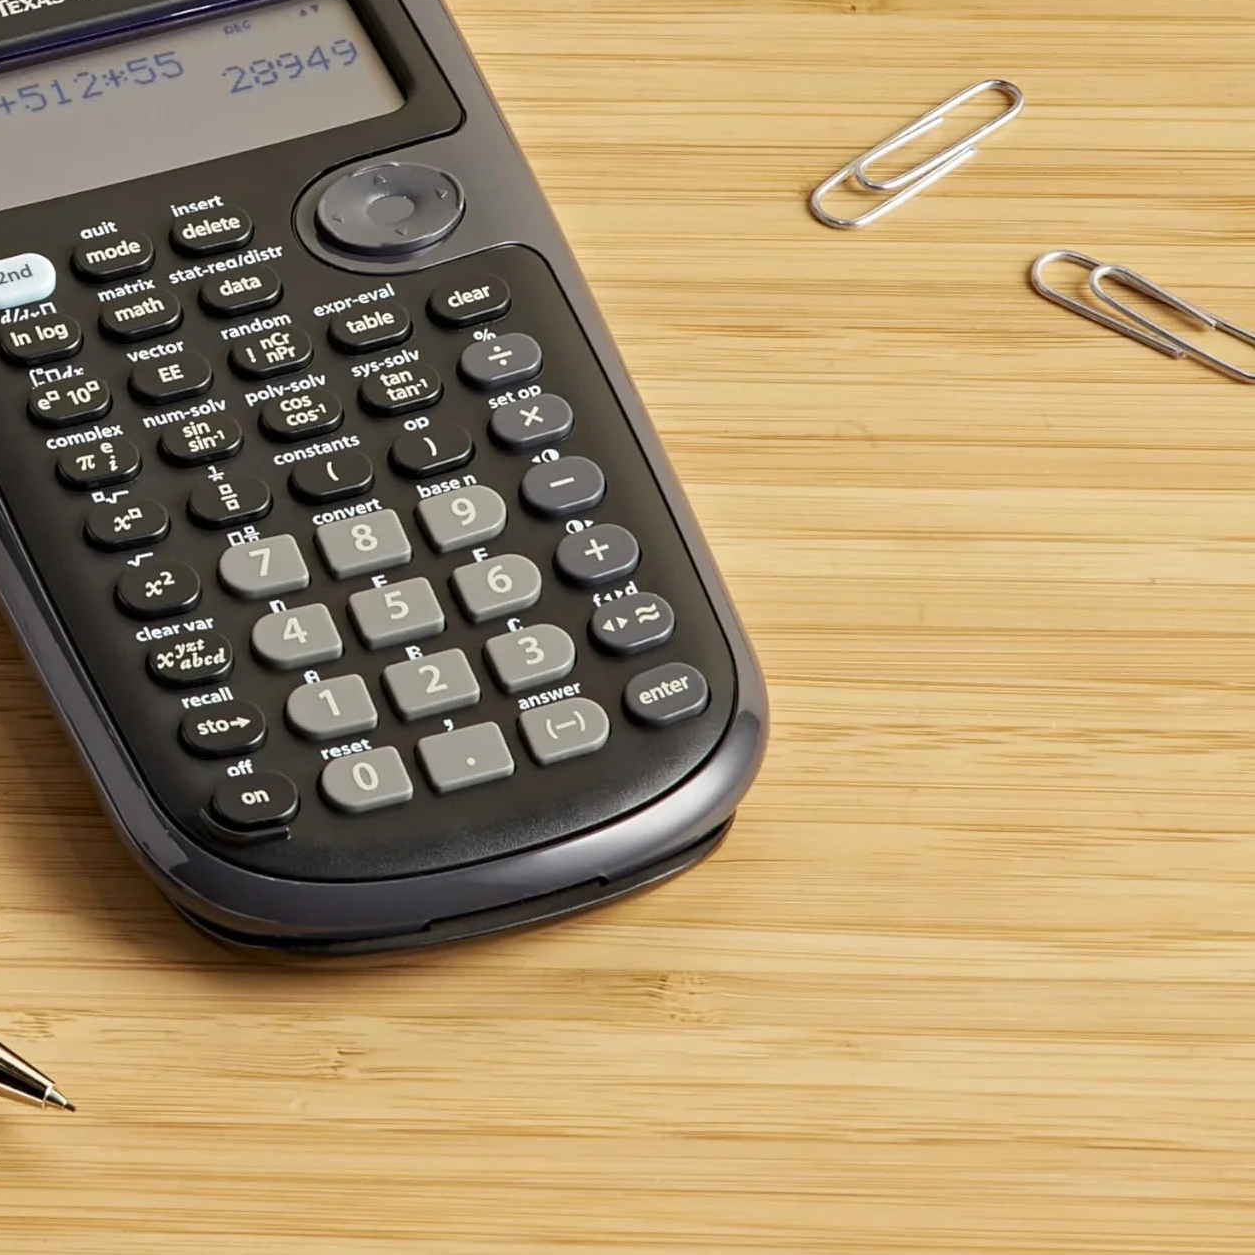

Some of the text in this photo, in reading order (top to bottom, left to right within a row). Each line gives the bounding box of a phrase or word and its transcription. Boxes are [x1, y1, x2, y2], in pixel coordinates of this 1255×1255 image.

[224, 21, 251, 35] DEG
[221, 39, 358, 93] 28949
[170, 195, 224, 218] insert
[182, 215, 241, 241] delete
[86, 239, 141, 264] mode
[97, 277, 156, 303] matrix
[219, 273, 262, 297] data
[448, 284, 490, 308] clear
[114, 296, 165, 323] math
[313, 283, 395, 318] expr-eval
[35, 323, 68, 341] log
[220, 313, 292, 341] random
[345, 311, 395, 335] table
[126, 340, 184, 364] vector
[259, 331, 290, 349] nCr
[266, 346, 296, 364] nPr
[351, 347, 420, 378] sys-solv
[158, 365, 184, 384] EE
[380, 369, 413, 387] tan
[280, 395, 312, 412] cos
[488, 384, 542, 410] set op
[142, 398, 227, 428] num-solv
[404, 415, 430, 432] op
[46, 424, 124, 450] complex
[182, 419, 211, 438] sin
[273, 434, 360, 466] constants
[416, 473, 477, 499] base n
[313, 498, 383, 526] convert
[451, 497, 477, 526] 9
[350, 523, 378, 552] 8
[248, 547, 271, 577] 7
[487, 565, 513, 593] 6
[384, 590, 409, 620] 5
[135, 617, 214, 643] clear var
[282, 617, 308, 645] 4
[517, 635, 545, 665] 3
[418, 665, 448, 694] 2
[639, 674, 690, 706] enter
[181, 686, 234, 710] recall
[317, 689, 341, 717] 1
[518, 682, 581, 711] answer
[320, 738, 373, 761] reset
[226, 758, 254, 778] off
[352, 762, 379, 792] 0
[240, 788, 270, 805] on
